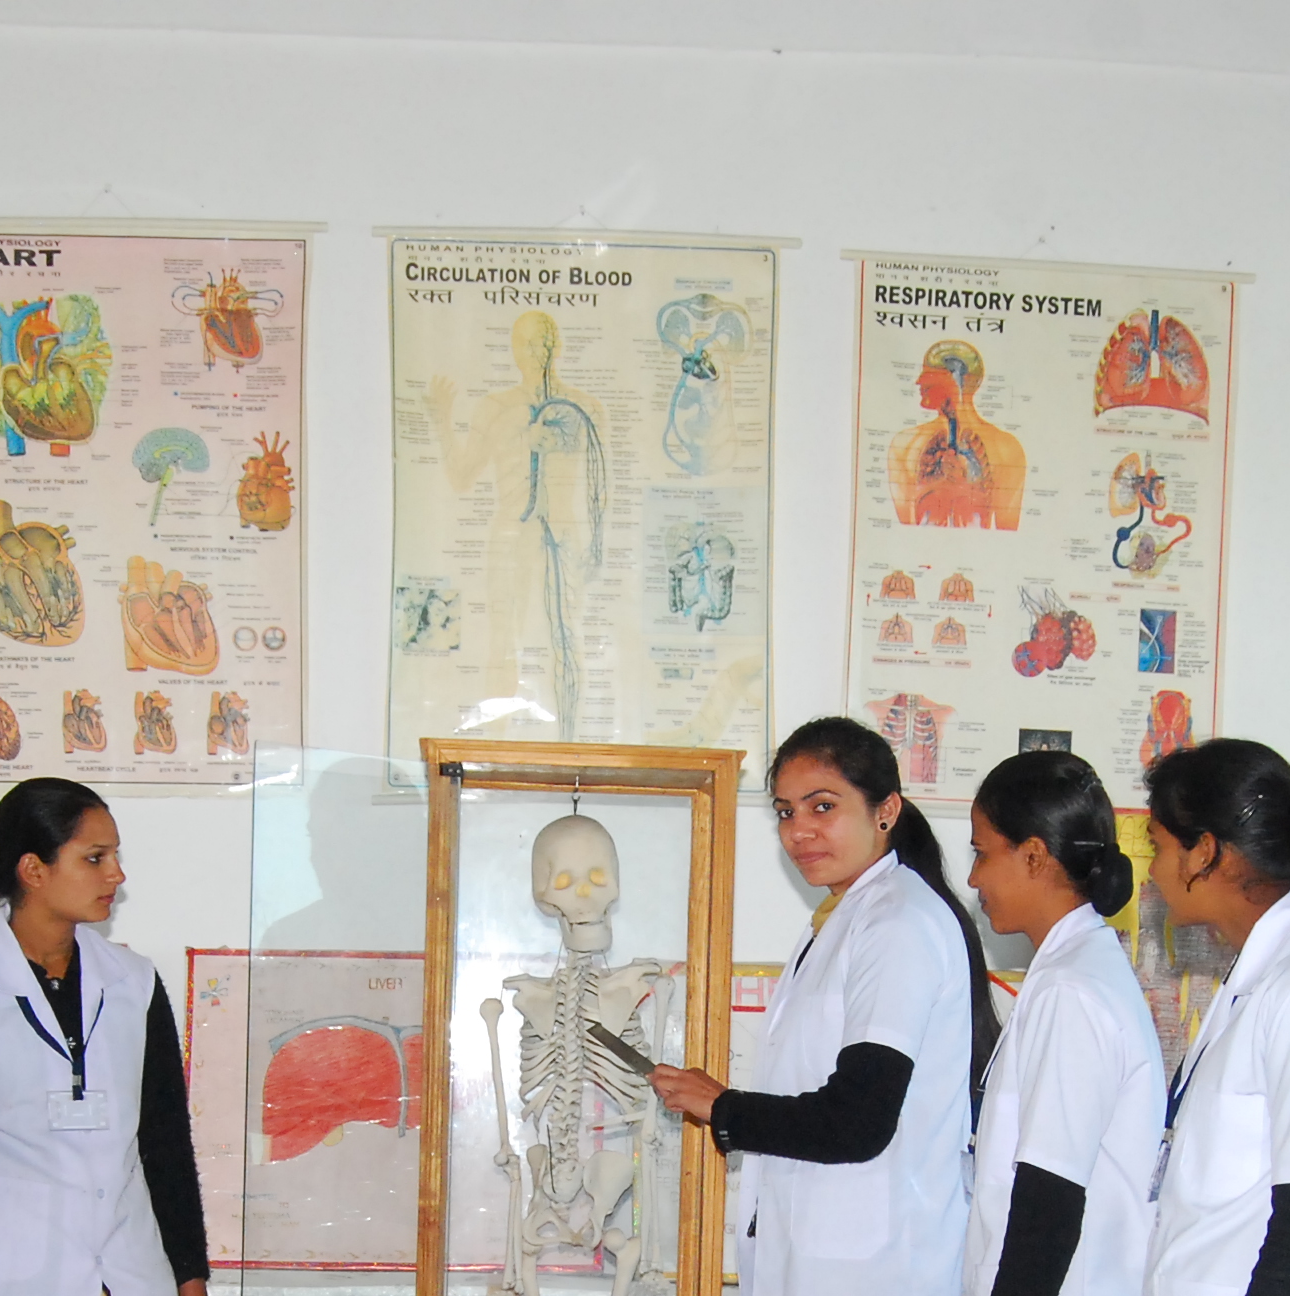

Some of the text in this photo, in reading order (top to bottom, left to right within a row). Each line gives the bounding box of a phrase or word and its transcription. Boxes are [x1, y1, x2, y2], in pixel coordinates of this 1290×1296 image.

[406, 244, 464, 252] HUMAN
[875, 262, 1000, 277] HUMAN PHYSIOLOGY
[406, 285, 600, 307] रक्त परिसंचरण
[875, 285, 1102, 317] RESPIRATORY SYSTEM
[874, 310, 1007, 333] श्वसन तंत्र
[369, 978, 403, 989] LIVER
